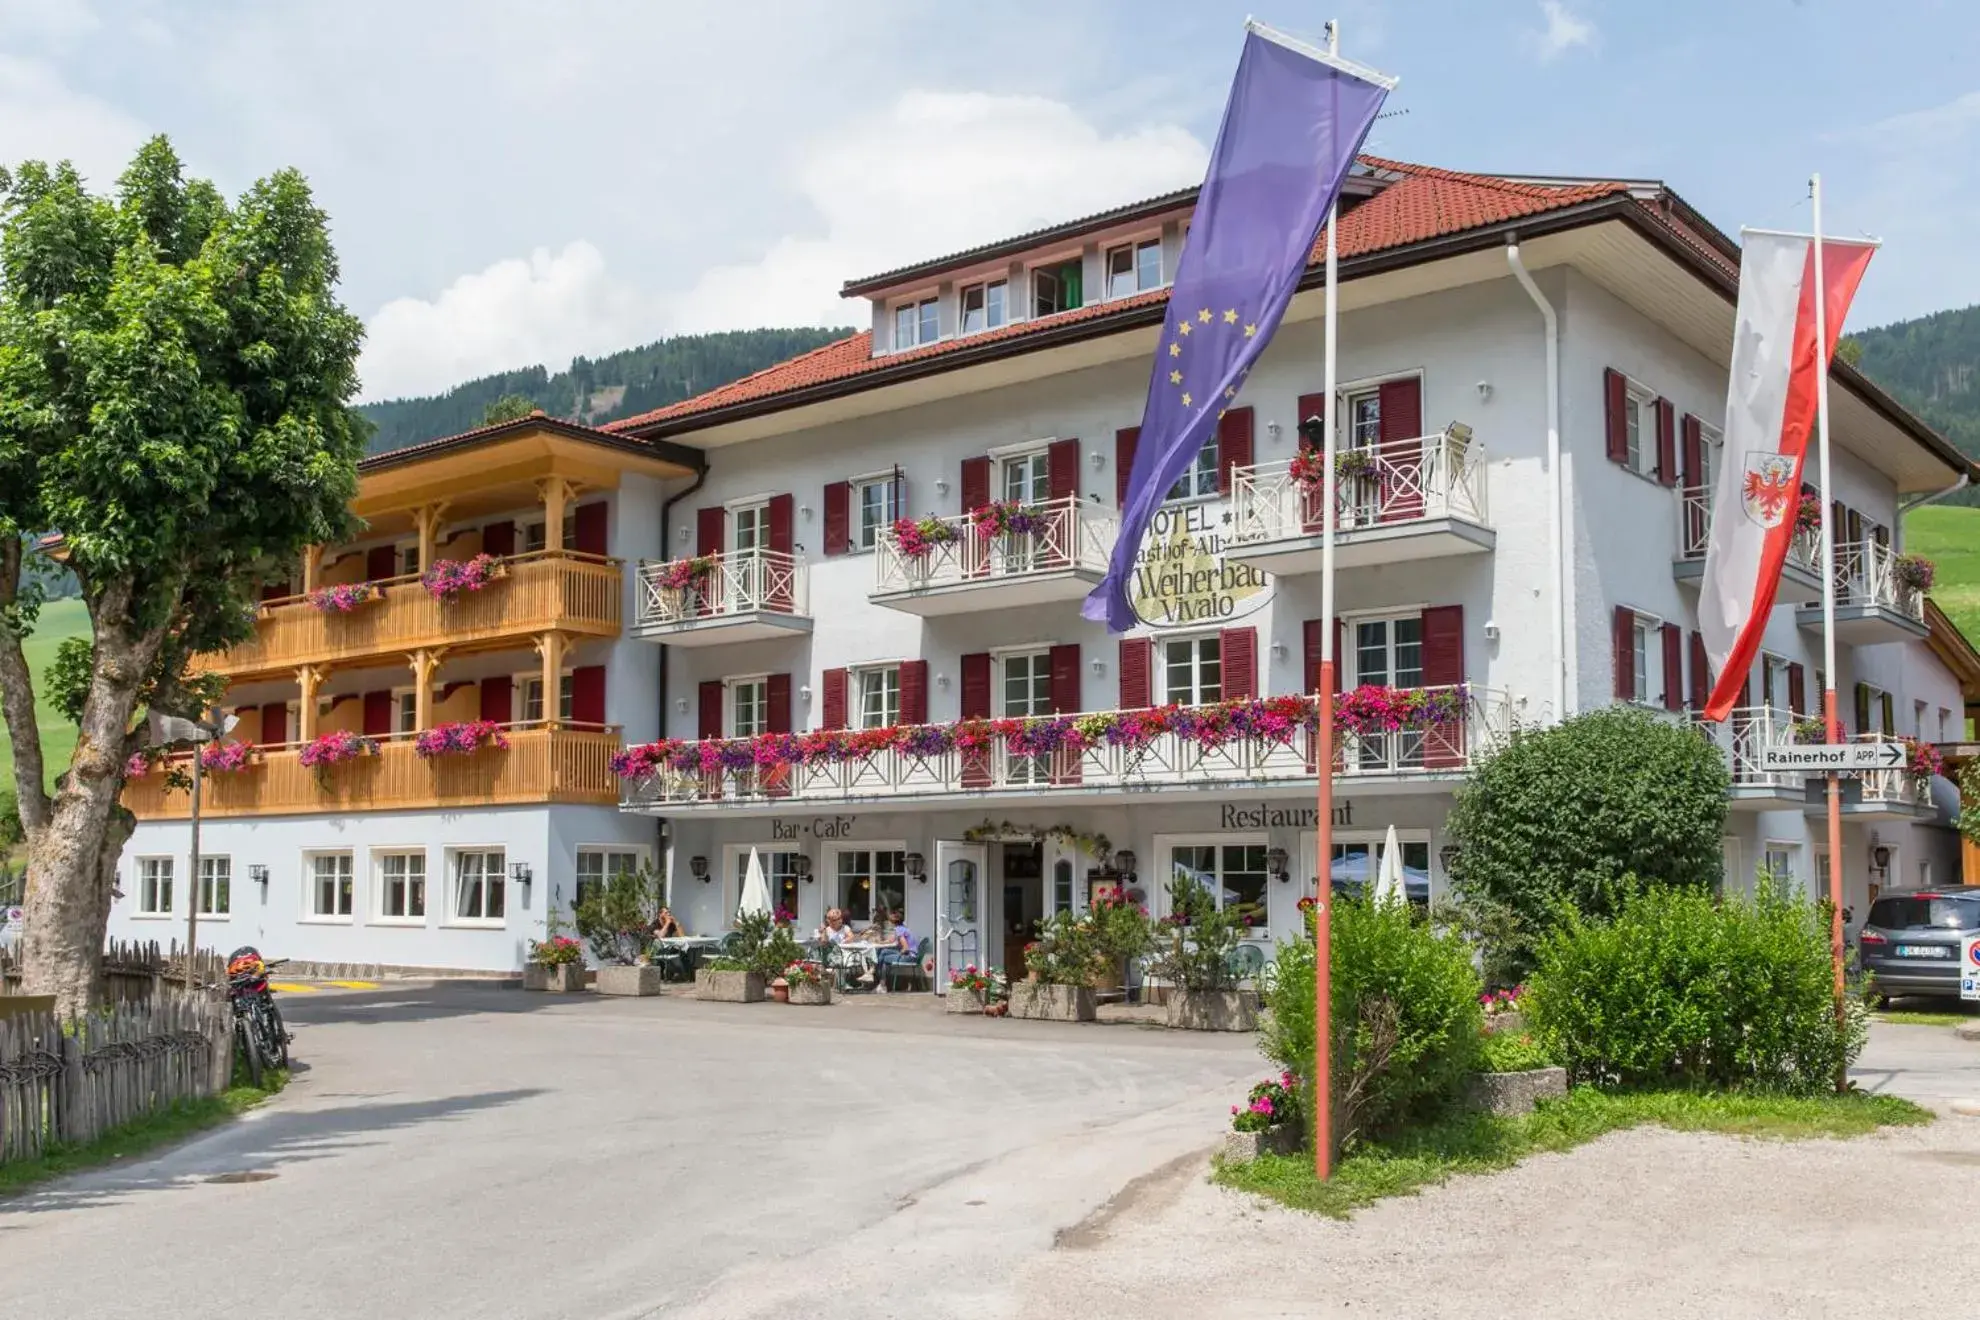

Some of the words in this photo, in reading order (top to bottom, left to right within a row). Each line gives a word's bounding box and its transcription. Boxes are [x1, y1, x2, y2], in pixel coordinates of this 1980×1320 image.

[1149, 504, 1215, 536] OTEL
[1136, 557, 1268, 599] Weiherbad
[1160, 592, 1234, 621] Vivaio
[1767, 751, 1846, 763] Rainerhof
[772, 819, 800, 839] Bar
